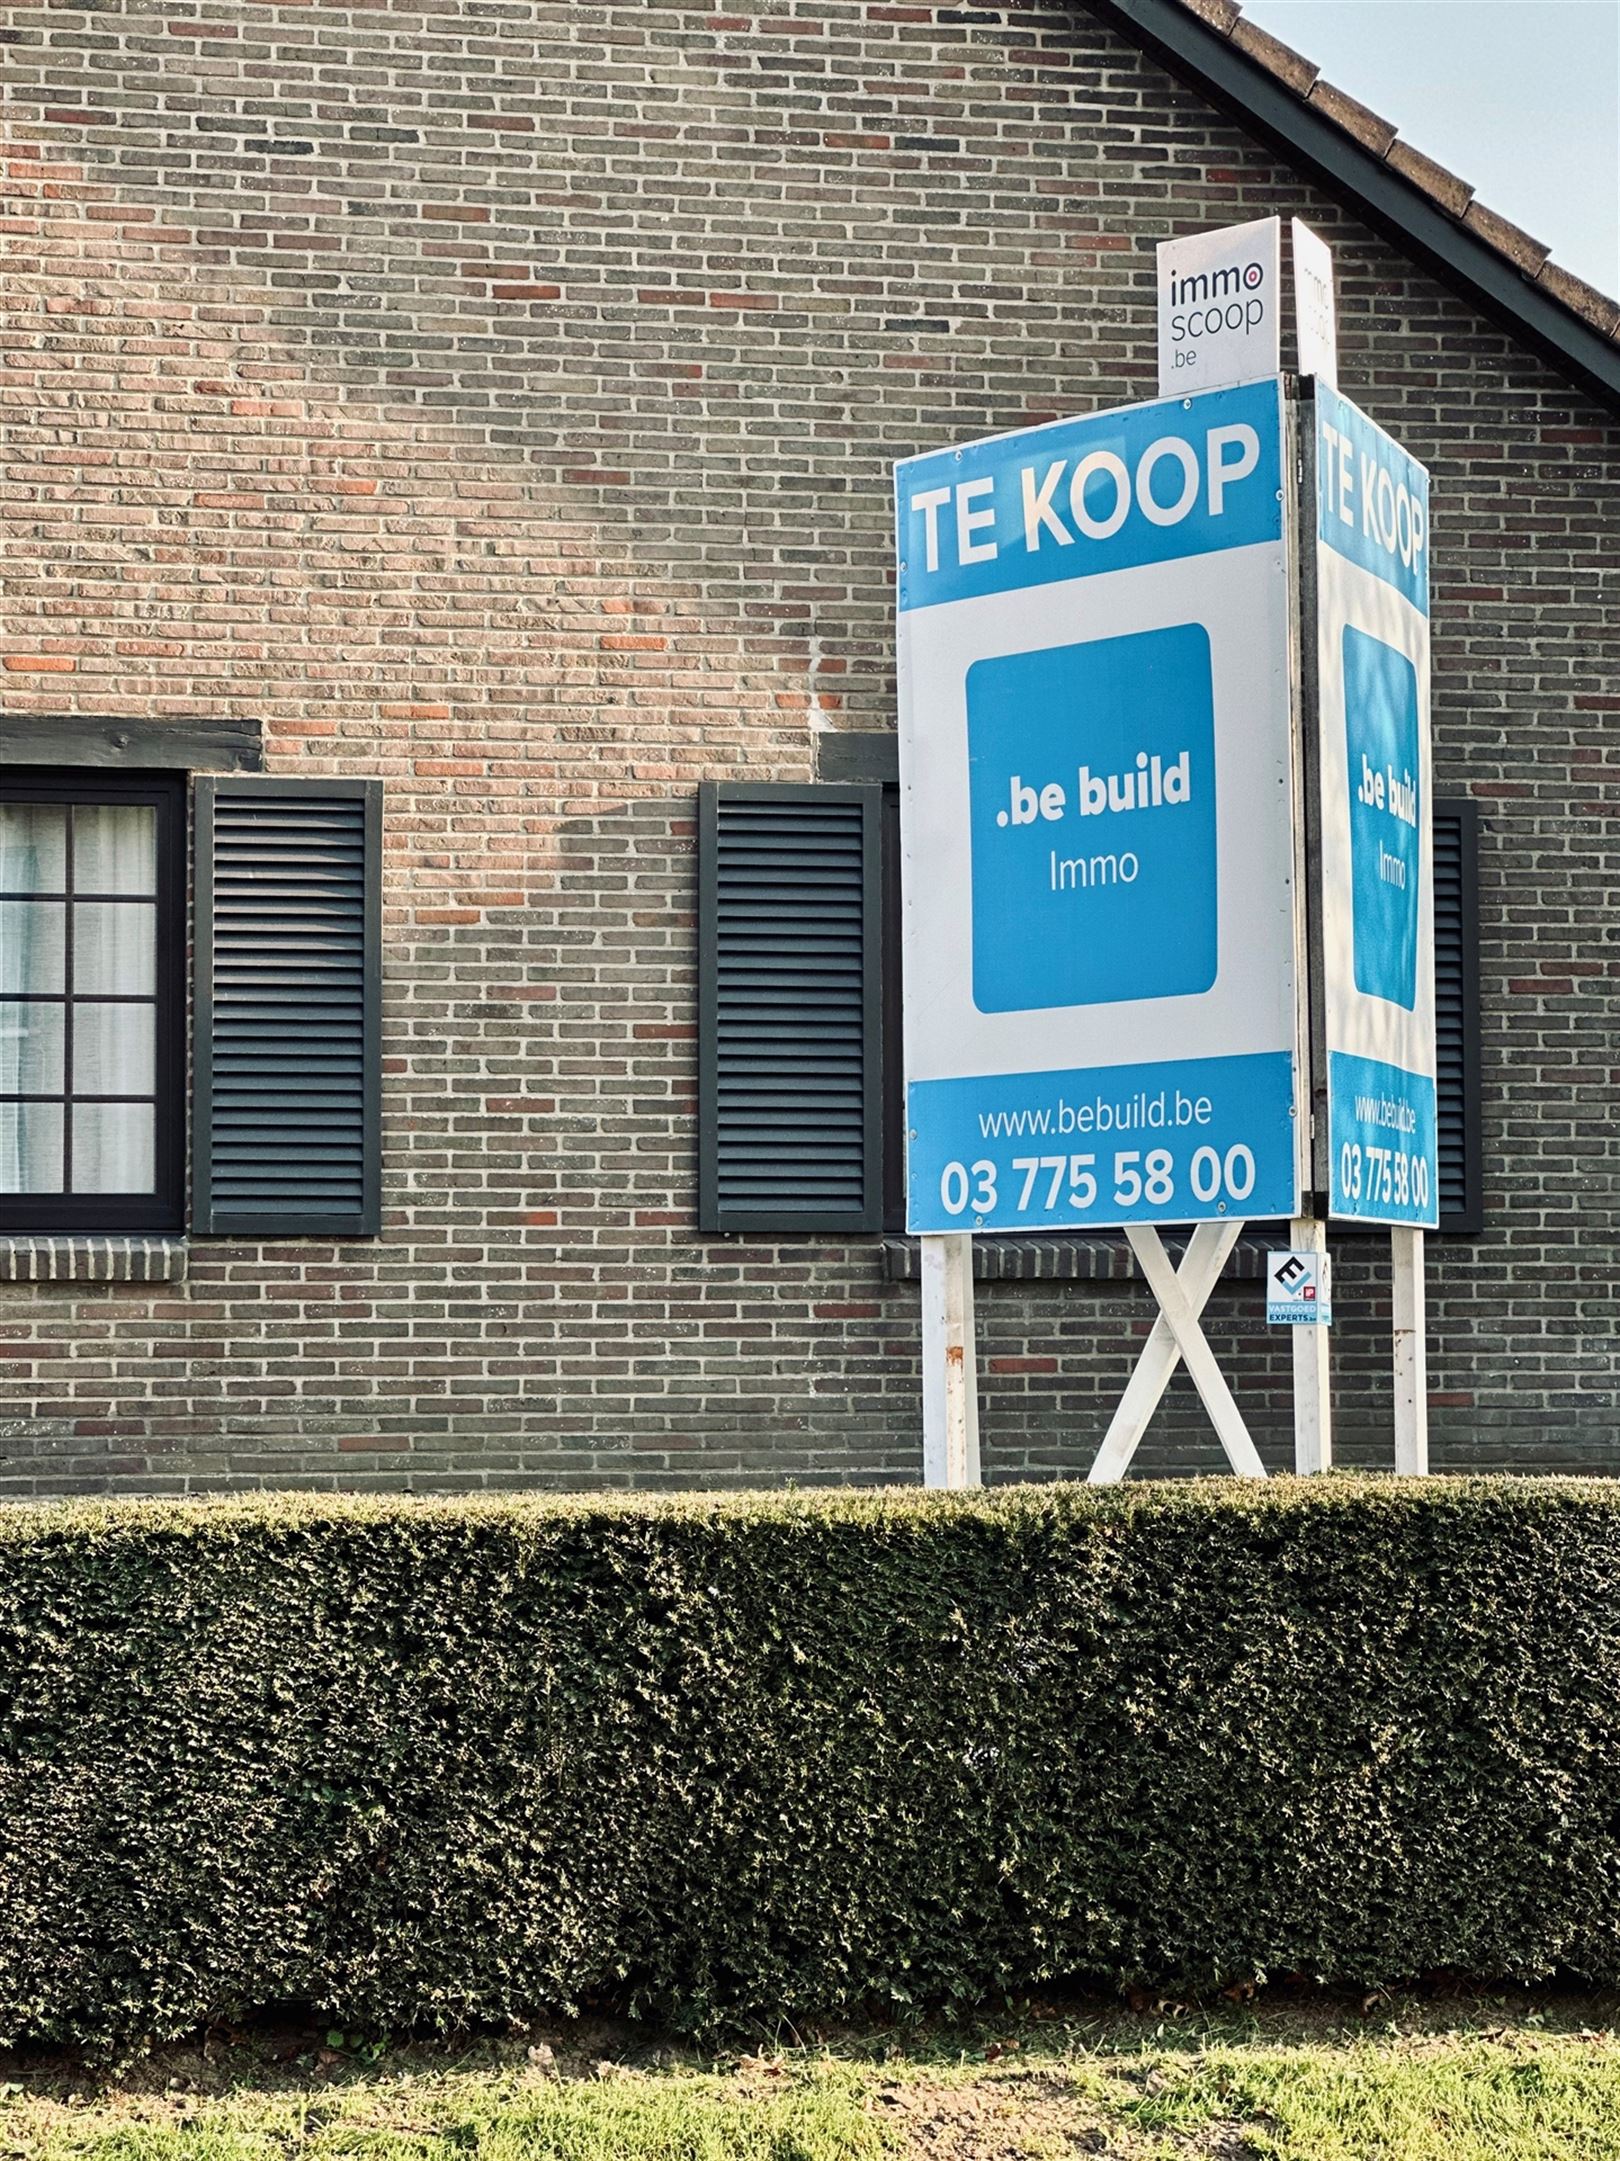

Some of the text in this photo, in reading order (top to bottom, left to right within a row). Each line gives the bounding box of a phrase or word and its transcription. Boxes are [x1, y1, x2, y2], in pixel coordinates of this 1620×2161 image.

[1171, 262, 1263, 307] immo
[1171, 299, 1264, 342] scoop
[1171, 349, 1197, 369] .be
[911, 423, 1261, 573] TE KOOP
[1323, 421, 1424, 577] TE KOOP
[996, 751, 1191, 828] .be build
[1358, 753, 1417, 829] .be build
[1051, 850, 1139, 891] Immo
[1379, 839, 1406, 891] Immo
[978, 1090, 1213, 1139] www.bebuild.be
[1354, 1091, 1416, 1135] www.bebuild.be
[940, 1143, 1256, 1216] 03 775 58 00
[1341, 1141, 1429, 1209] 03 775 58 00
[1268, 1304, 1316, 1313] VASTGOED
